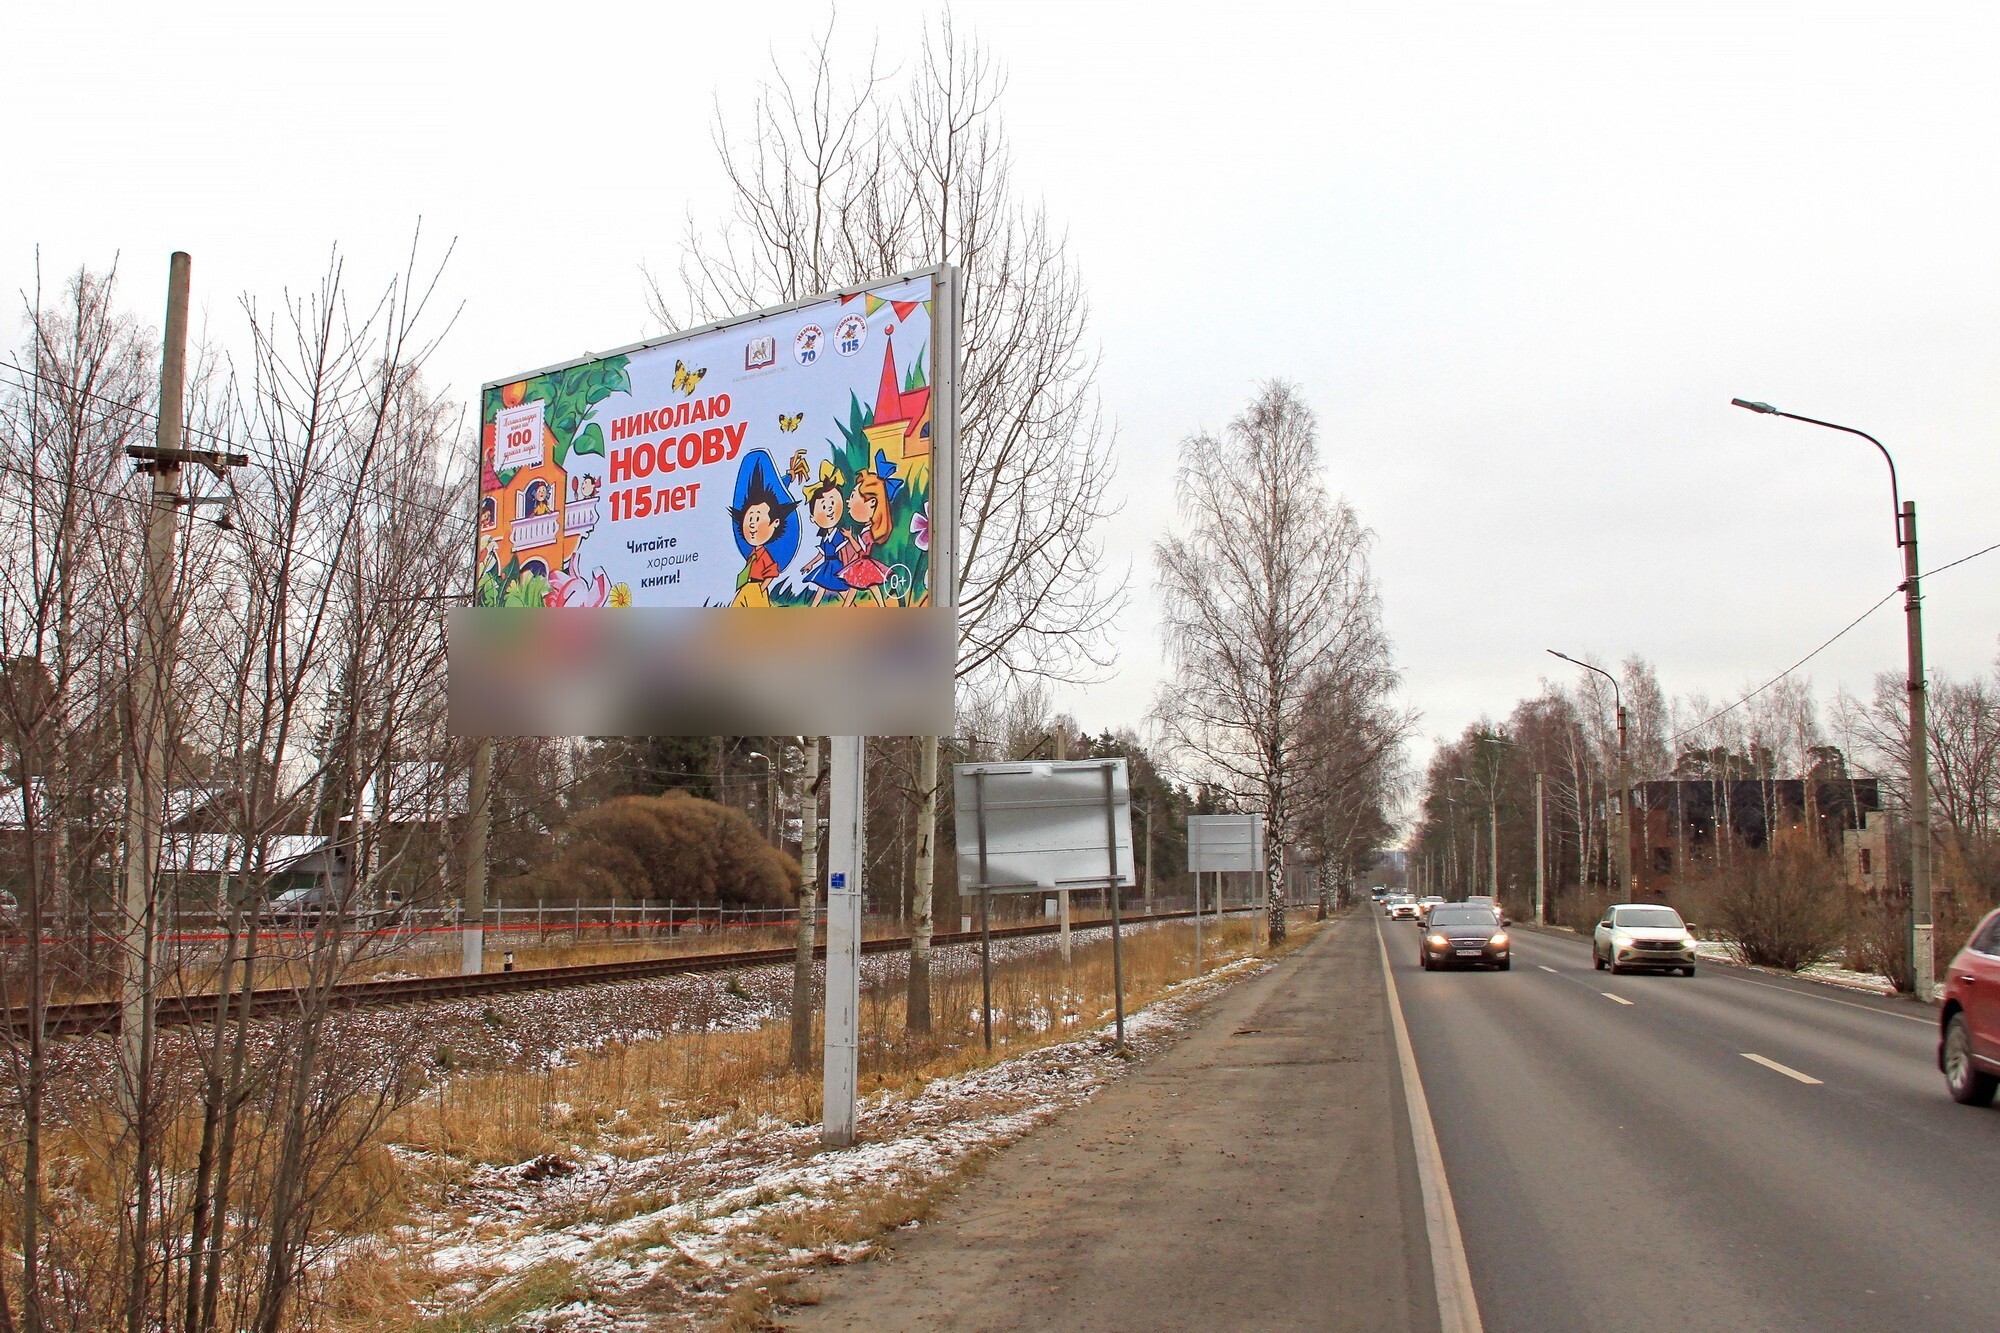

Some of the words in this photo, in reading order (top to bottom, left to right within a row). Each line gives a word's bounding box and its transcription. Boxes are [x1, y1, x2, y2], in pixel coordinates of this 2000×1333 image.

[841, 338, 860, 354] 115
[801, 350, 816, 364] 70
[611, 393, 731, 441] НИКОЛАЮ
[507, 428, 532, 448] 100
[609, 421, 749, 484] НОСОВУ
[609, 485, 652, 522] 115
[653, 483, 701, 515] лет
[626, 536, 677, 553] Читайте
[647, 552, 699, 571] хорошие
[641, 569, 681, 588] книги!
[890, 574, 907, 589] 0+
